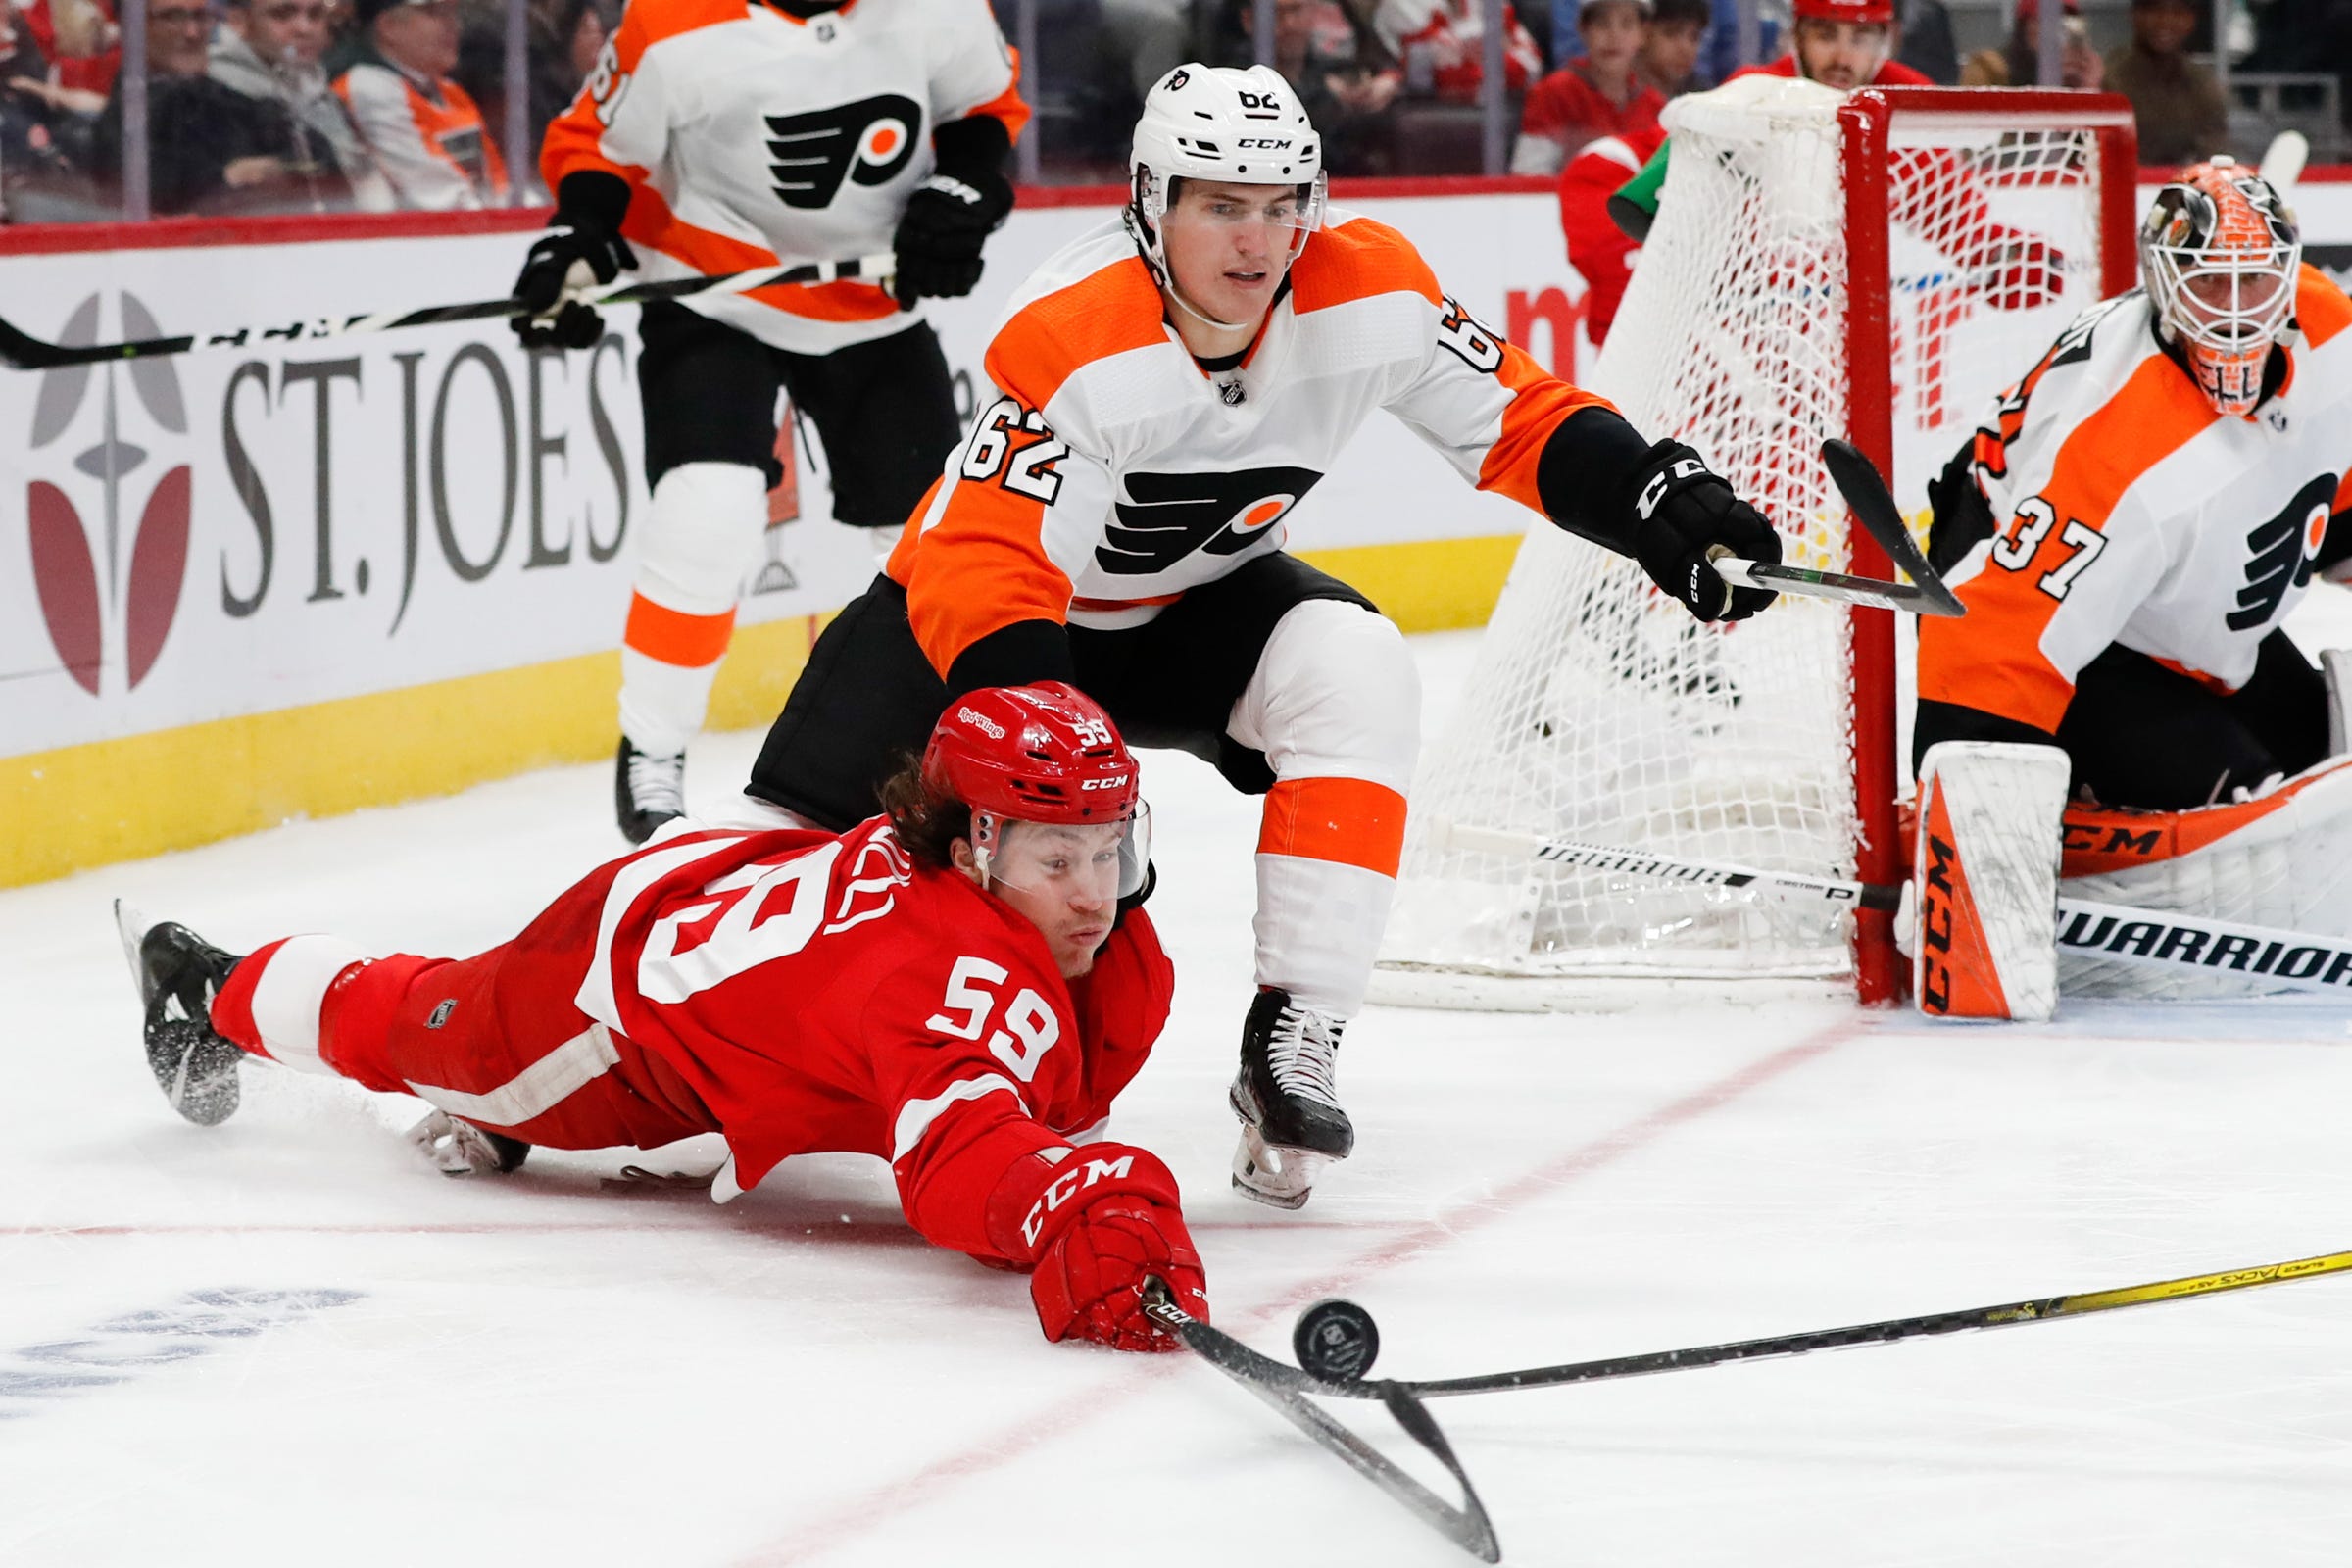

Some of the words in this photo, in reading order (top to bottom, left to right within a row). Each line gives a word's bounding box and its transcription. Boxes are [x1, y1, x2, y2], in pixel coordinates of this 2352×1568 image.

[1238, 138, 1292, 149] CCM
[1437, 293, 1507, 373] 6
[388, 333, 629, 639] JOES
[960, 395, 1070, 507] 62
[1635, 458, 1707, 520] CC
[1690, 563, 1701, 604] CCM
[1992, 495, 2108, 603] 37
[958, 707, 979, 724] Red
[976, 713, 1005, 739] Wings
[1072, 718, 1114, 747] 59
[1081, 774, 1128, 791] CCM
[2062, 825, 2162, 856] CM
[638, 840, 844, 1004] 9
[1925, 834, 1955, 1015] CCM
[924, 956, 1060, 1082] 59
[1020, 1156, 1135, 1247] CCM
